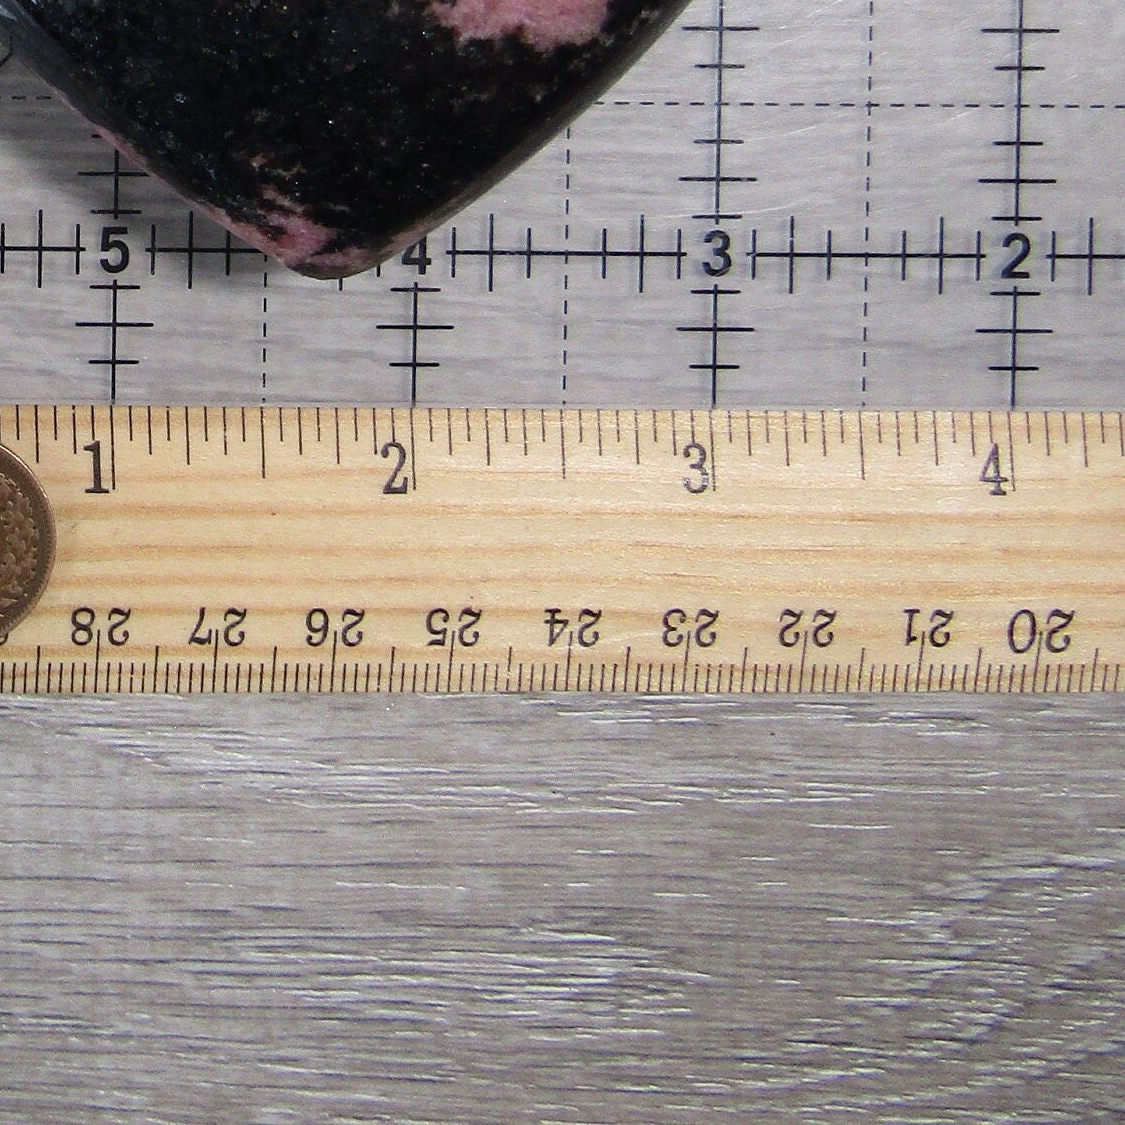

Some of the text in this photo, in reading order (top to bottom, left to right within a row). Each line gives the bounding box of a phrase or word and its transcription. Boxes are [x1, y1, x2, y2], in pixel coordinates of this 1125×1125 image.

[99, 226, 130, 273] 5
[401, 235, 432, 276] 4
[702, 230, 733, 277] 3
[1001, 233, 1031, 279] 2
[83, 441, 110, 494] 1
[381, 441, 409, 495] 2
[683, 442, 709, 494] 3
[979, 443, 1008, 496] 4
[70, 606, 132, 646] 28
[187, 606, 248, 647] 27
[305, 607, 365, 647] 26
[425, 607, 483, 648] 25
[543, 607, 603, 648] 24
[661, 607, 721, 648] 23
[778, 608, 837, 648] 22
[903, 608, 955, 648] 21
[1007, 608, 1075, 654] 20
